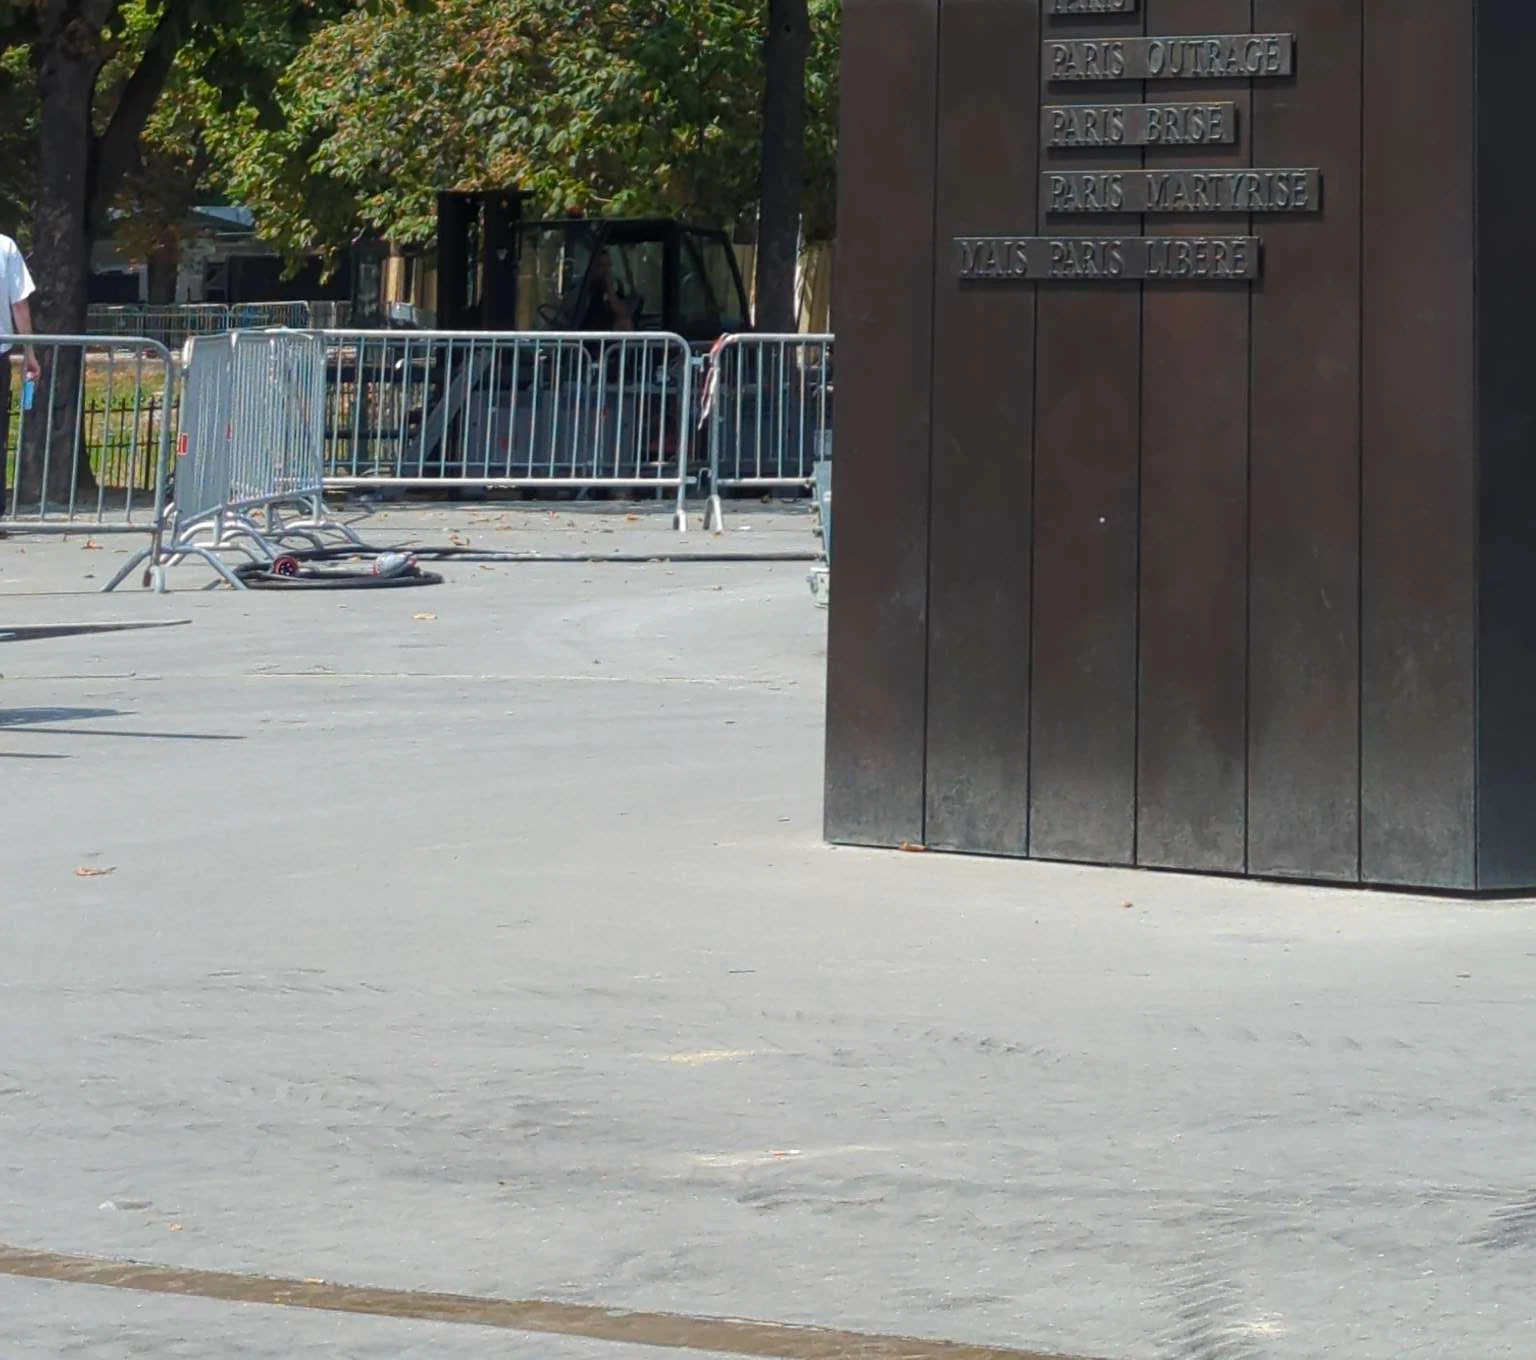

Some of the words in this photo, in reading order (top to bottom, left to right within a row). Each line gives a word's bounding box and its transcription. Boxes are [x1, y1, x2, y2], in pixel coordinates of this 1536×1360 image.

[1050, 42, 1125, 79] PARIS
[1148, 34, 1281, 77] OUTRAGÉ
[1049, 108, 1125, 145] PARIS
[1145, 102, 1223, 143] BRISÉ
[1049, 174, 1124, 211] PARIS
[1145, 169, 1310, 210] MARTYRISÉ
[959, 240, 1029, 278] MAIS
[1048, 239, 1124, 278] PARIS
[1144, 236, 1250, 277] LIBÉRÉ
